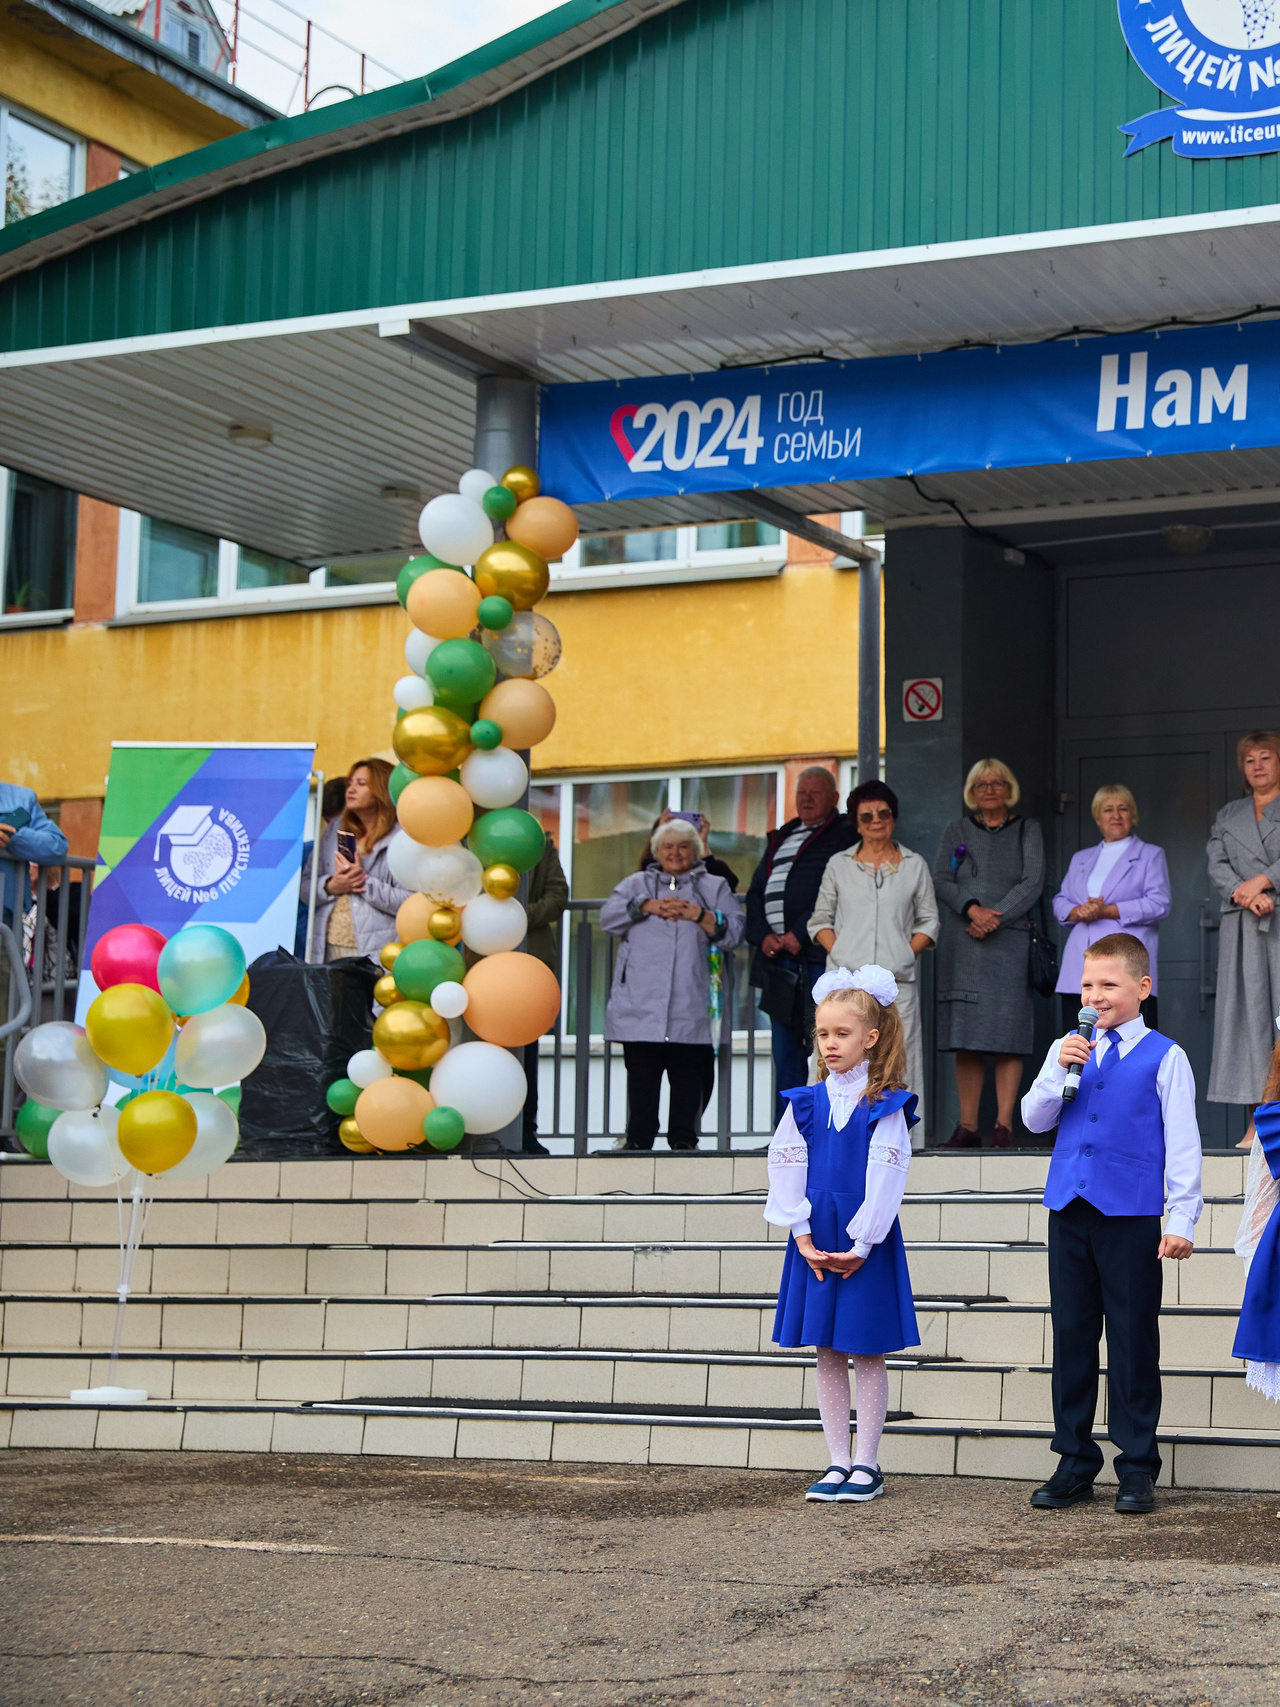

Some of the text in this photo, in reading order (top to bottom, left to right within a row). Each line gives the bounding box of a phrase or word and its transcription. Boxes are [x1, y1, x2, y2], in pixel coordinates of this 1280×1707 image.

[1145, 14, 1243, 92] ЛИЦЕЙ
[1096, 351, 1249, 432] Нам
[627, 395, 764, 473] 2024
[154, 807, 250, 904] ЛИЦЕЙ №6 ПЕРСПЕКТИВА
